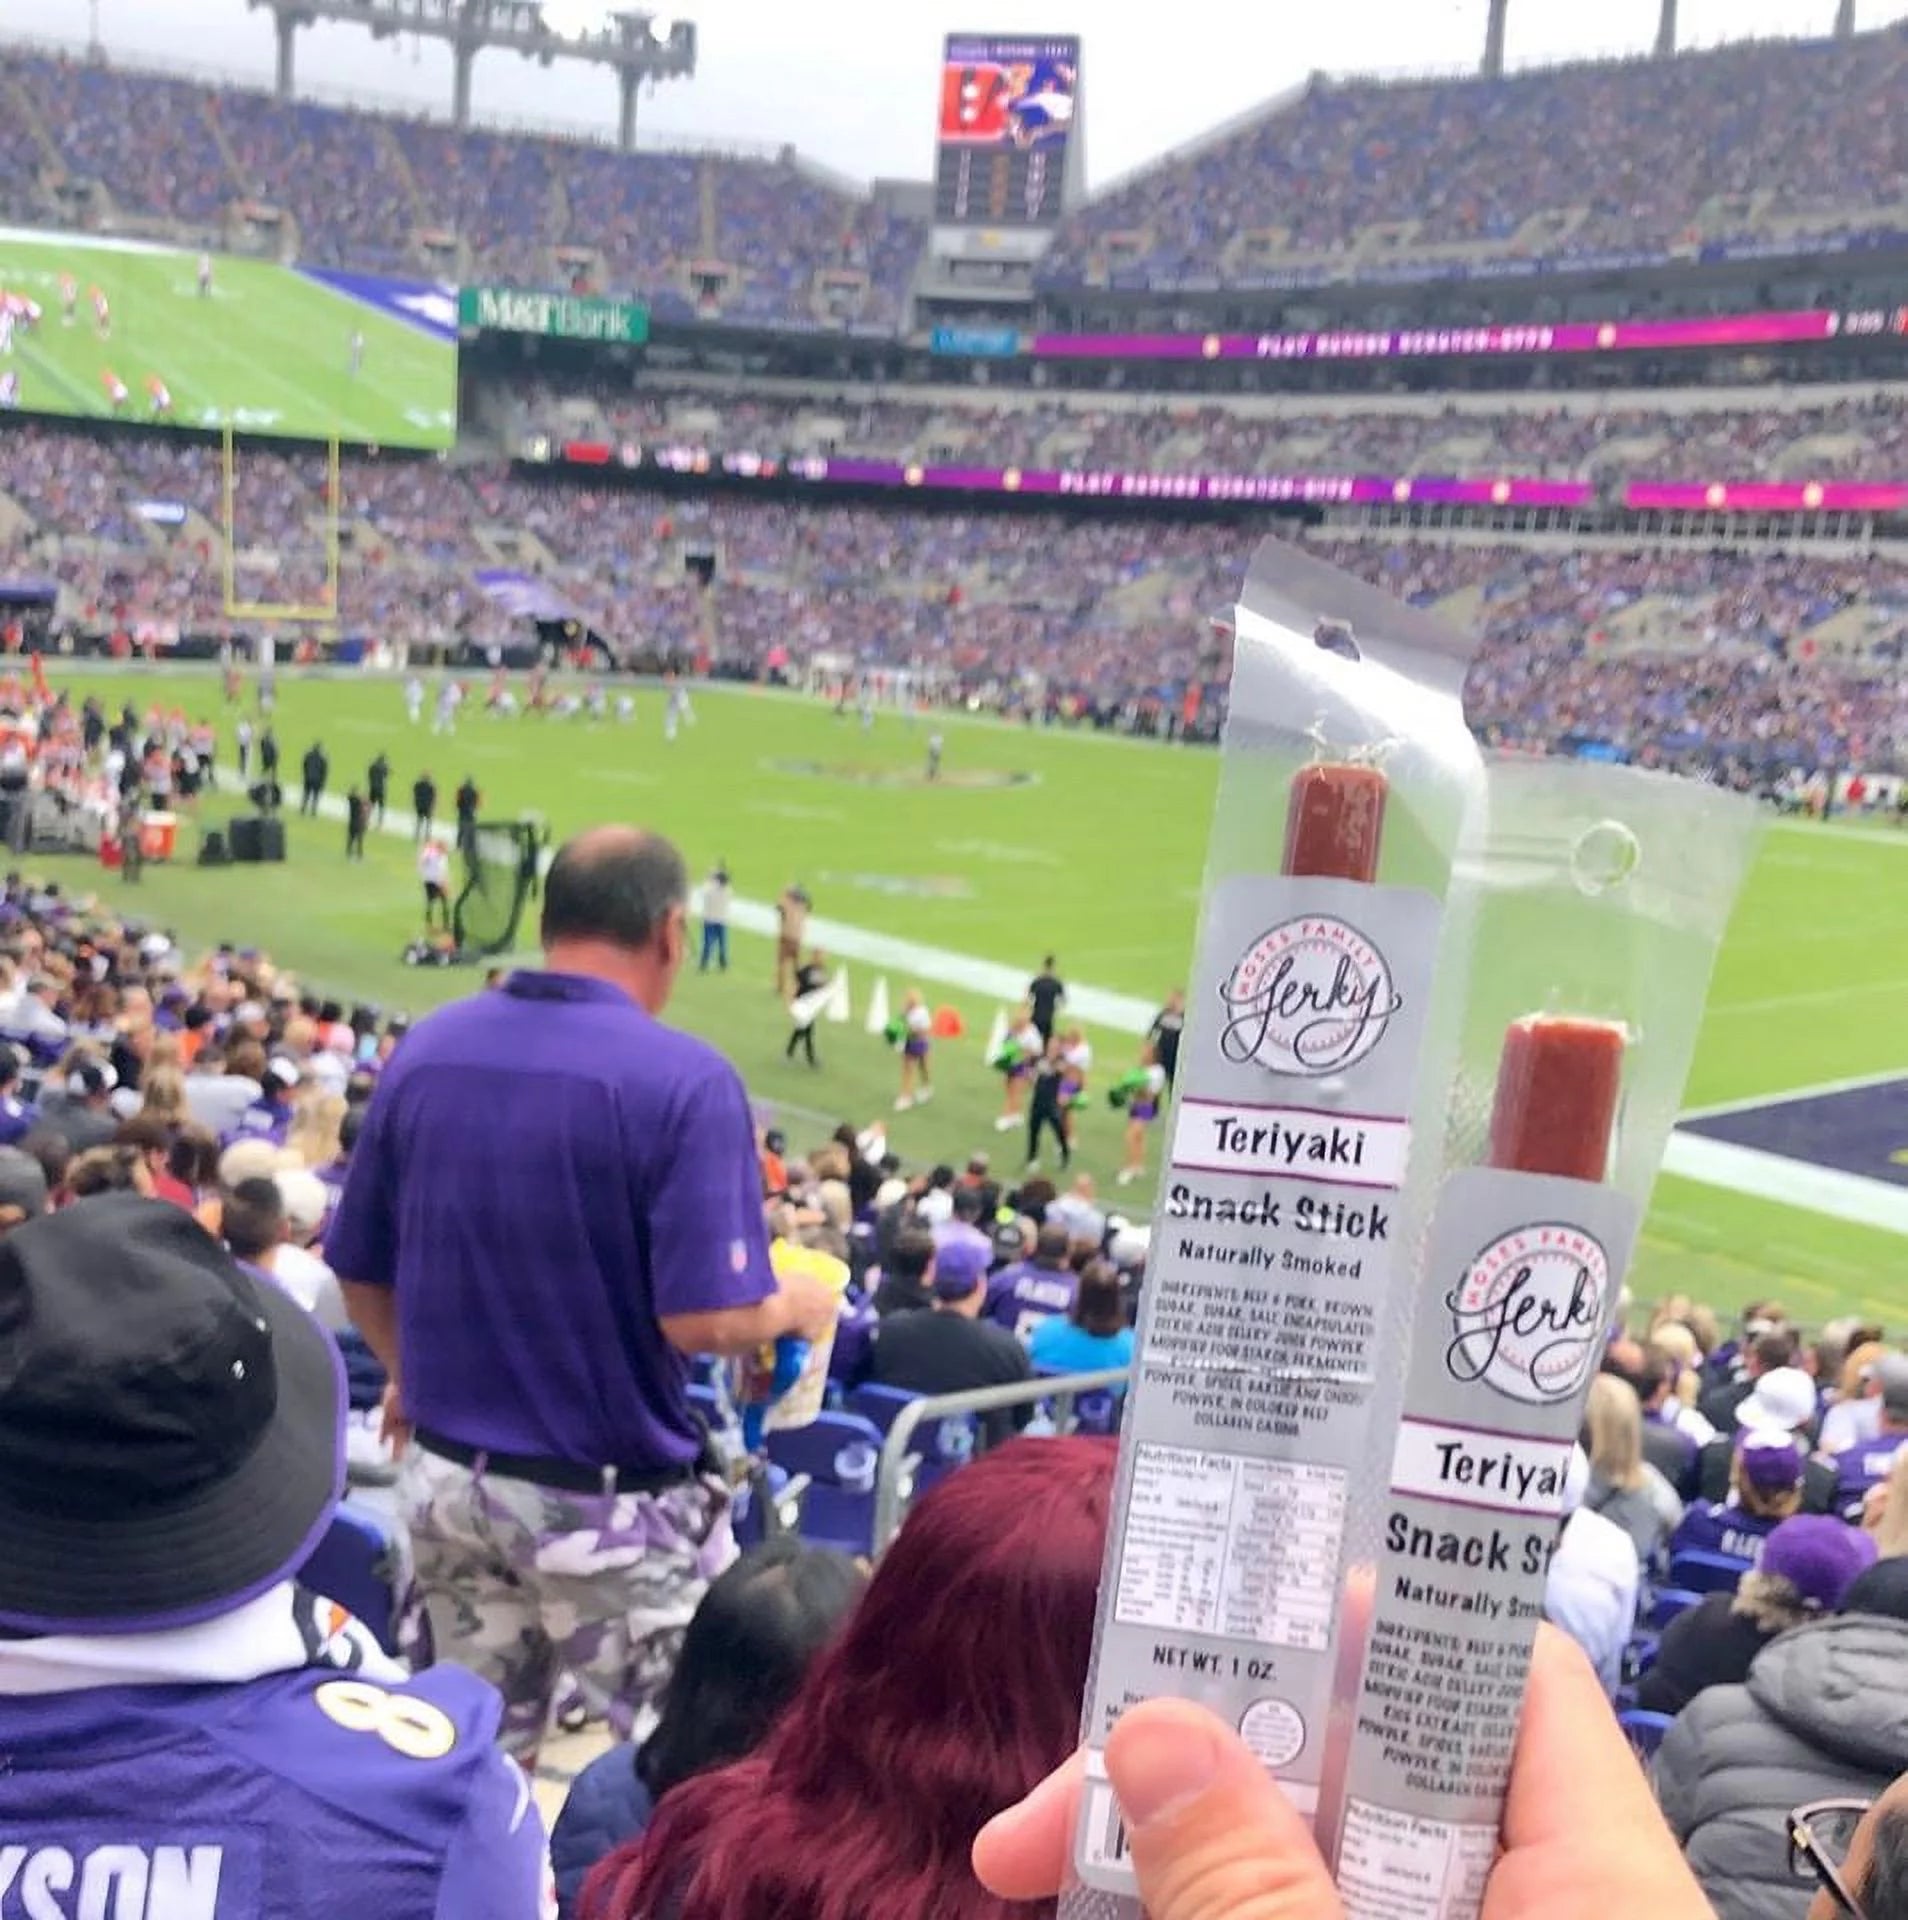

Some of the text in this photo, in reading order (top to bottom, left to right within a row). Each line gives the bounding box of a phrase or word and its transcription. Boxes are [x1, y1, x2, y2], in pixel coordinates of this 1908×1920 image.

[477, 287, 632, 342] M&T Bank
[1302, 922, 1377, 967] FAMILY
[1220, 954, 1402, 1064] Jerky
[1213, 1117, 1366, 1166] Teriyaki
[1170, 1184, 1389, 1242] Snack Stick
[1179, 1239, 1362, 1280] Naturally Smoked
[1386, 1512, 1511, 1572] Snack
[1394, 1576, 1502, 1618] Naturally
[1153, 1645, 1188, 1667] NET
[1232, 1657, 1240, 1677] 1
[315, 1680, 456, 1759] 8
